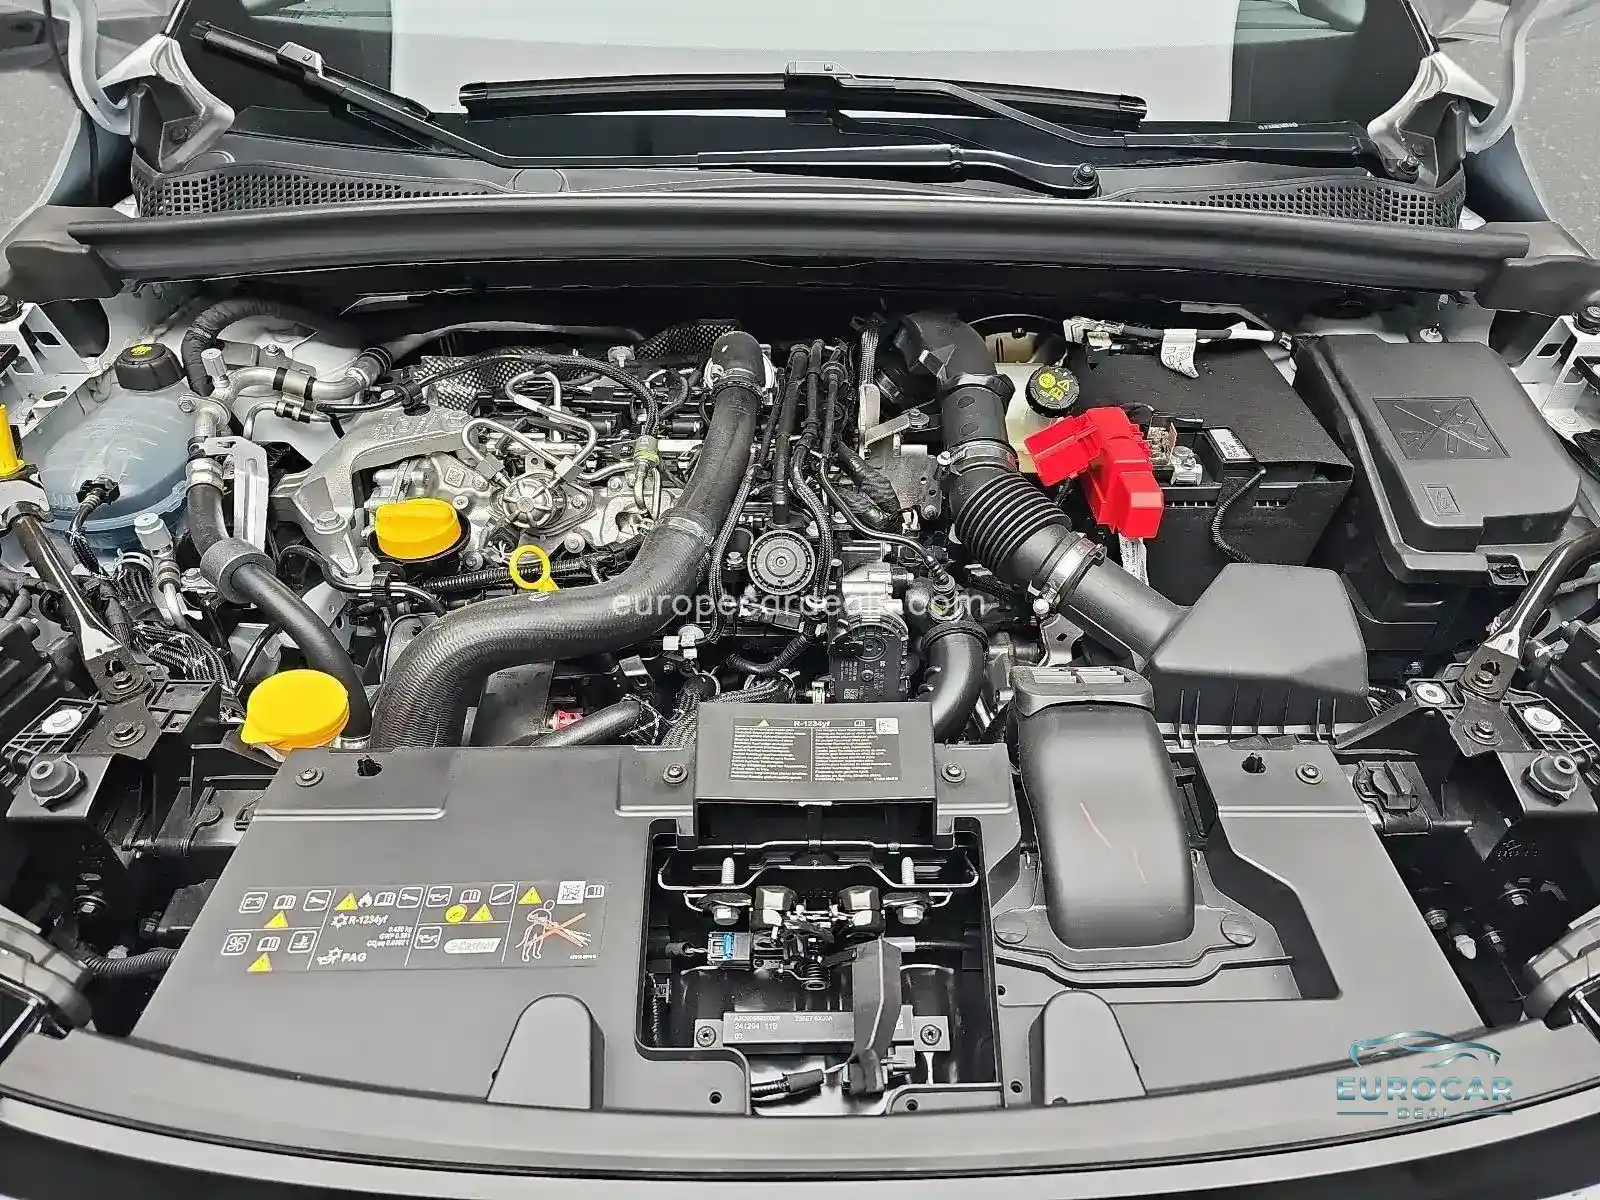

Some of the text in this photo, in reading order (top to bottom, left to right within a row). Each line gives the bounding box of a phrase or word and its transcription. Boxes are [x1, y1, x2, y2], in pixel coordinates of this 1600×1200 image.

[793, 720, 831, 729] R-1234yf
[348, 914, 389, 925] R-1234yf
[341, 953, 367, 963] PAG
